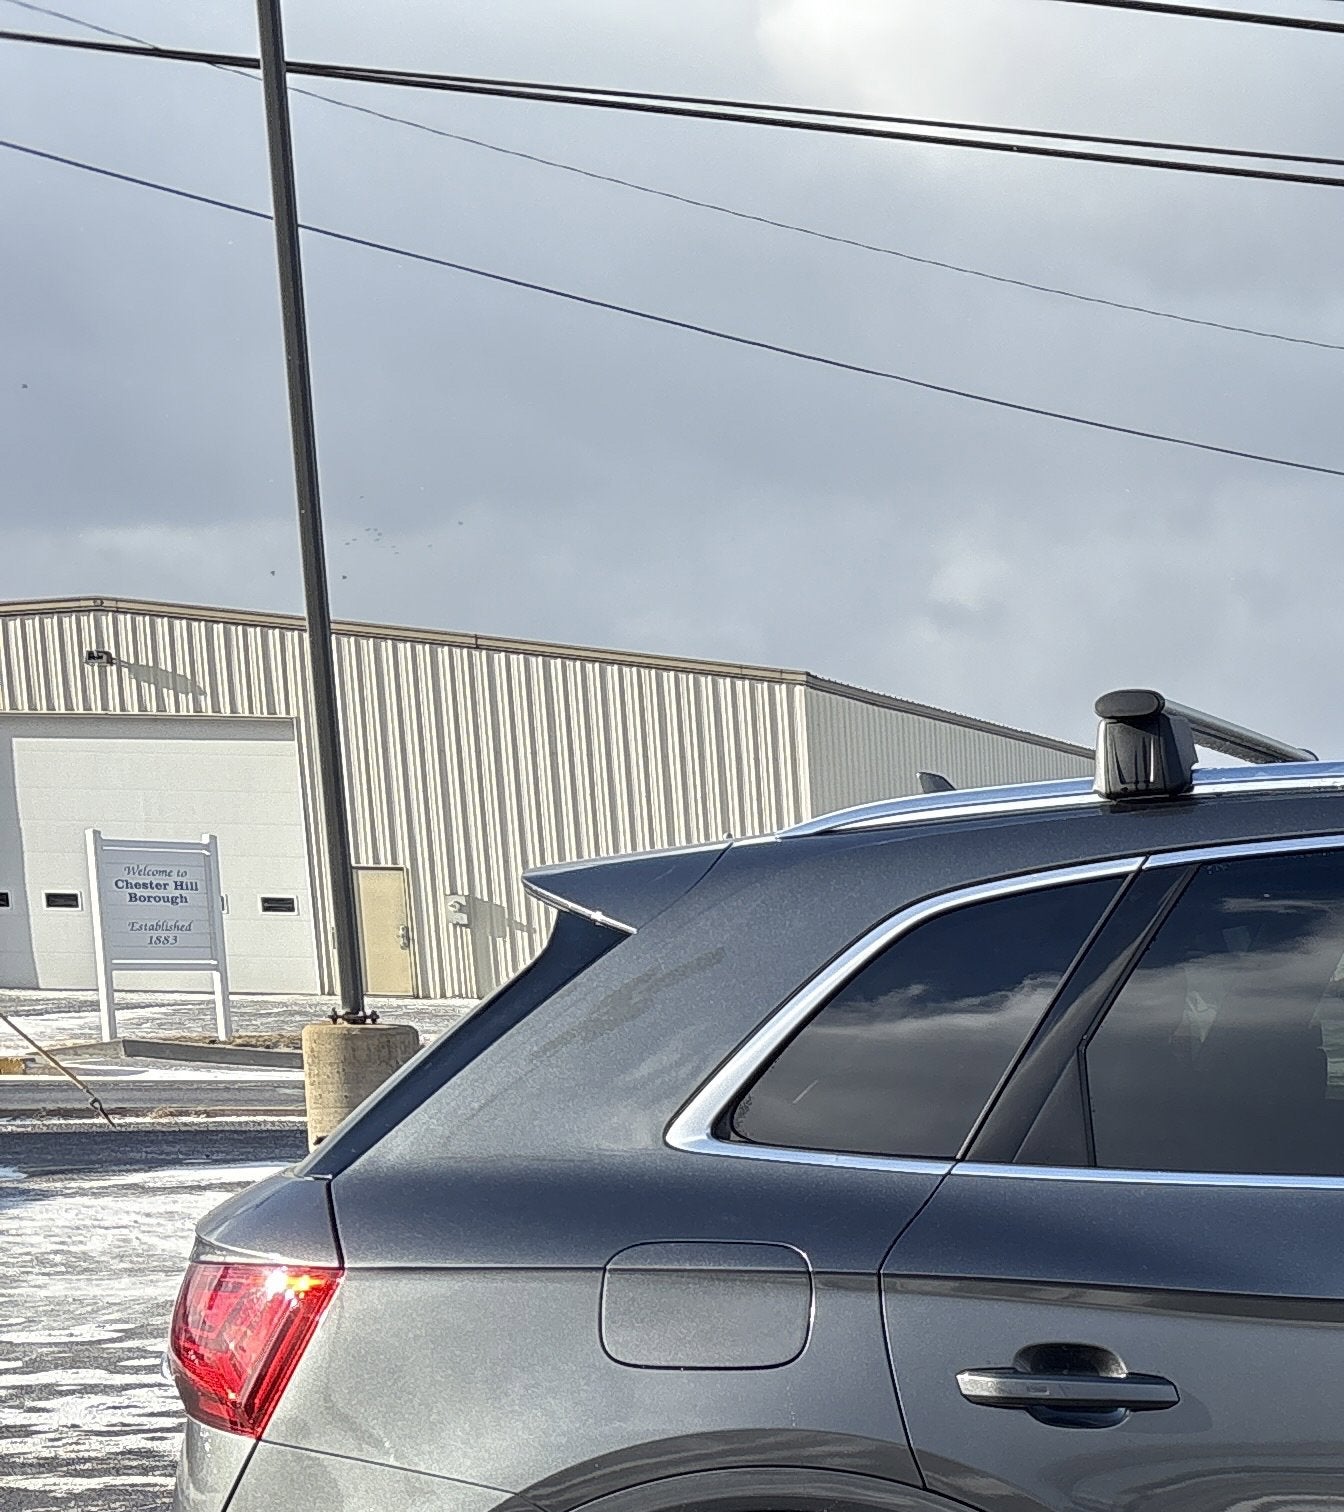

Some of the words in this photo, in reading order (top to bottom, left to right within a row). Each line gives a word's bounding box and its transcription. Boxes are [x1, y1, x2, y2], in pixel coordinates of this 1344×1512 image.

[124, 865, 173, 878] Welcome
[177, 868, 188, 878] to
[114, 879, 170, 891] Chester
[173, 880, 199, 892] Hill
[128, 892, 189, 906] Borough
[128, 920, 194, 932] Established
[147, 935, 178, 946] 1883
